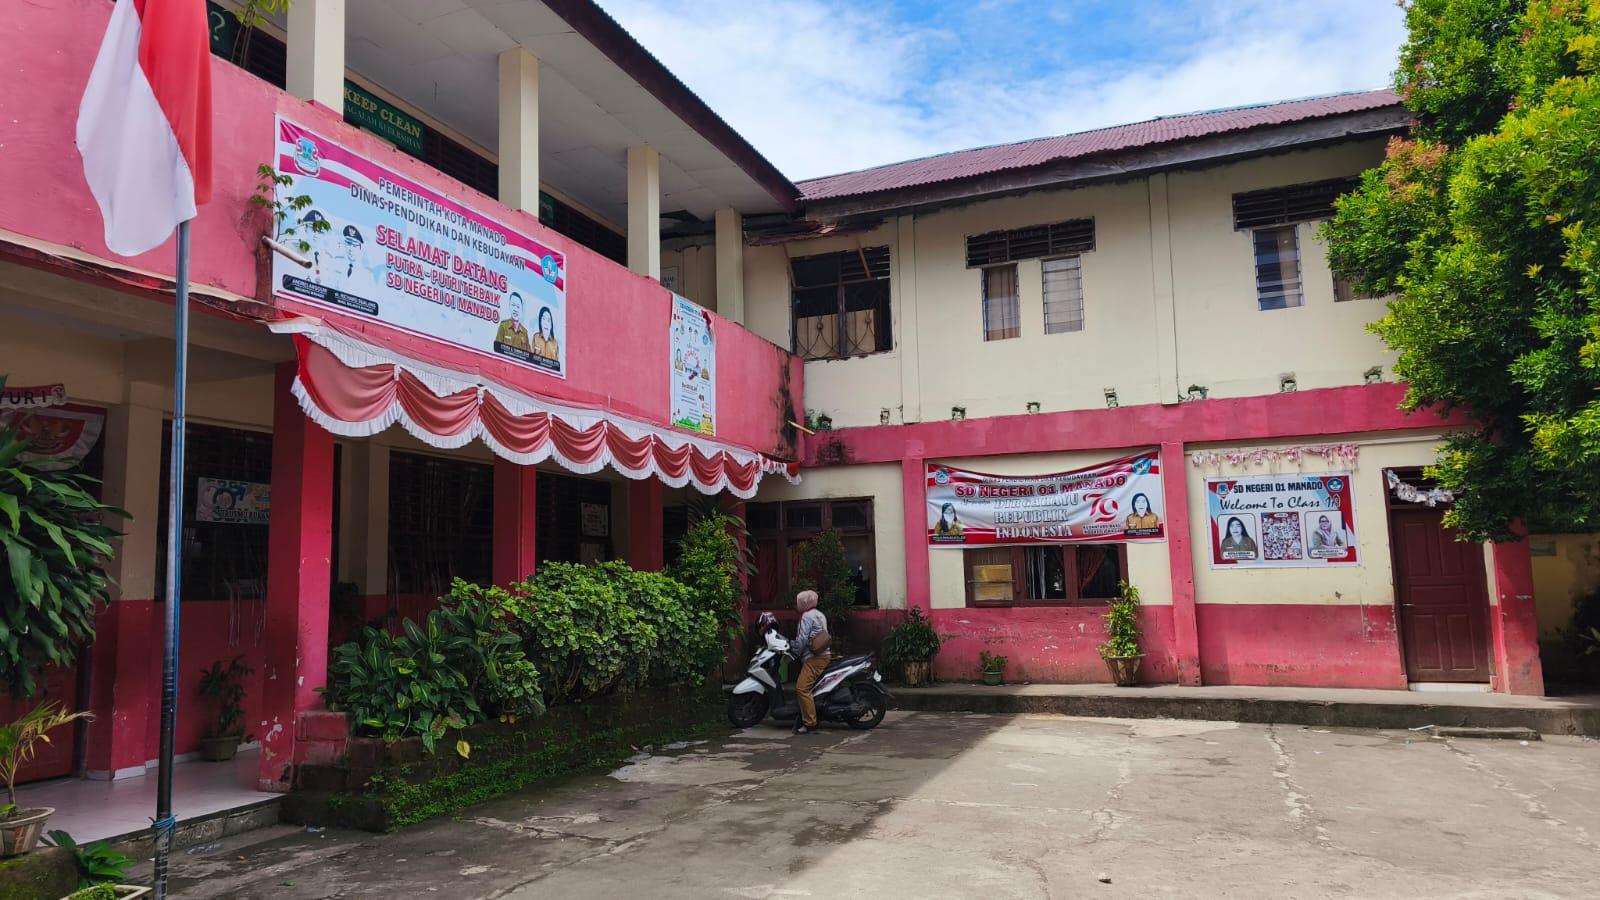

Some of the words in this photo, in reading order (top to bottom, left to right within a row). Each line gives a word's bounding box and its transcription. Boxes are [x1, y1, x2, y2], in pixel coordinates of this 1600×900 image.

[344, 87, 378, 113] KEEP
[380, 108, 421, 139] CLEAN
[351, 184, 385, 210] DINAS
[388, 201, 449, 237] PENDIDIKAN
[451, 230, 471, 247] DAN
[472, 239, 525, 271] KEBUDAYAAN
[379, 177, 444, 218] PEMERINTAH
[444, 210, 468, 229] KOTA
[469, 221, 507, 247] MANADO
[376, 225, 450, 270] SELAMAT
[452, 255, 508, 293] DATANG
[386, 252, 424, 279] PUTRA
[431, 269, 462, 293] PUTRI
[462, 281, 501, 308] TERBAIK
[386, 272, 403, 290] SD
[404, 279, 443, 305] NEGERI
[445, 292, 456, 309] 01
[457, 297, 500, 323] MANADO
[955, 485, 976, 498] SD
[979, 484, 1036, 498] NEGERI
[1038, 483, 1057, 496] 01
[1061, 474, 1127, 494] MANADO
[1220, 497, 1267, 511] Welcome
[1270, 496, 1284, 509] To
[1287, 496, 1320, 509] Class
[1233, 484, 1244, 494] SD
[1246, 483, 1273, 493] NEGERI
[1275, 482, 1286, 492] 01
[1288, 481, 1323, 491] MANADO
[994, 509, 1069, 524] REPUBLIK
[995, 525, 1073, 539] INDONESIA
